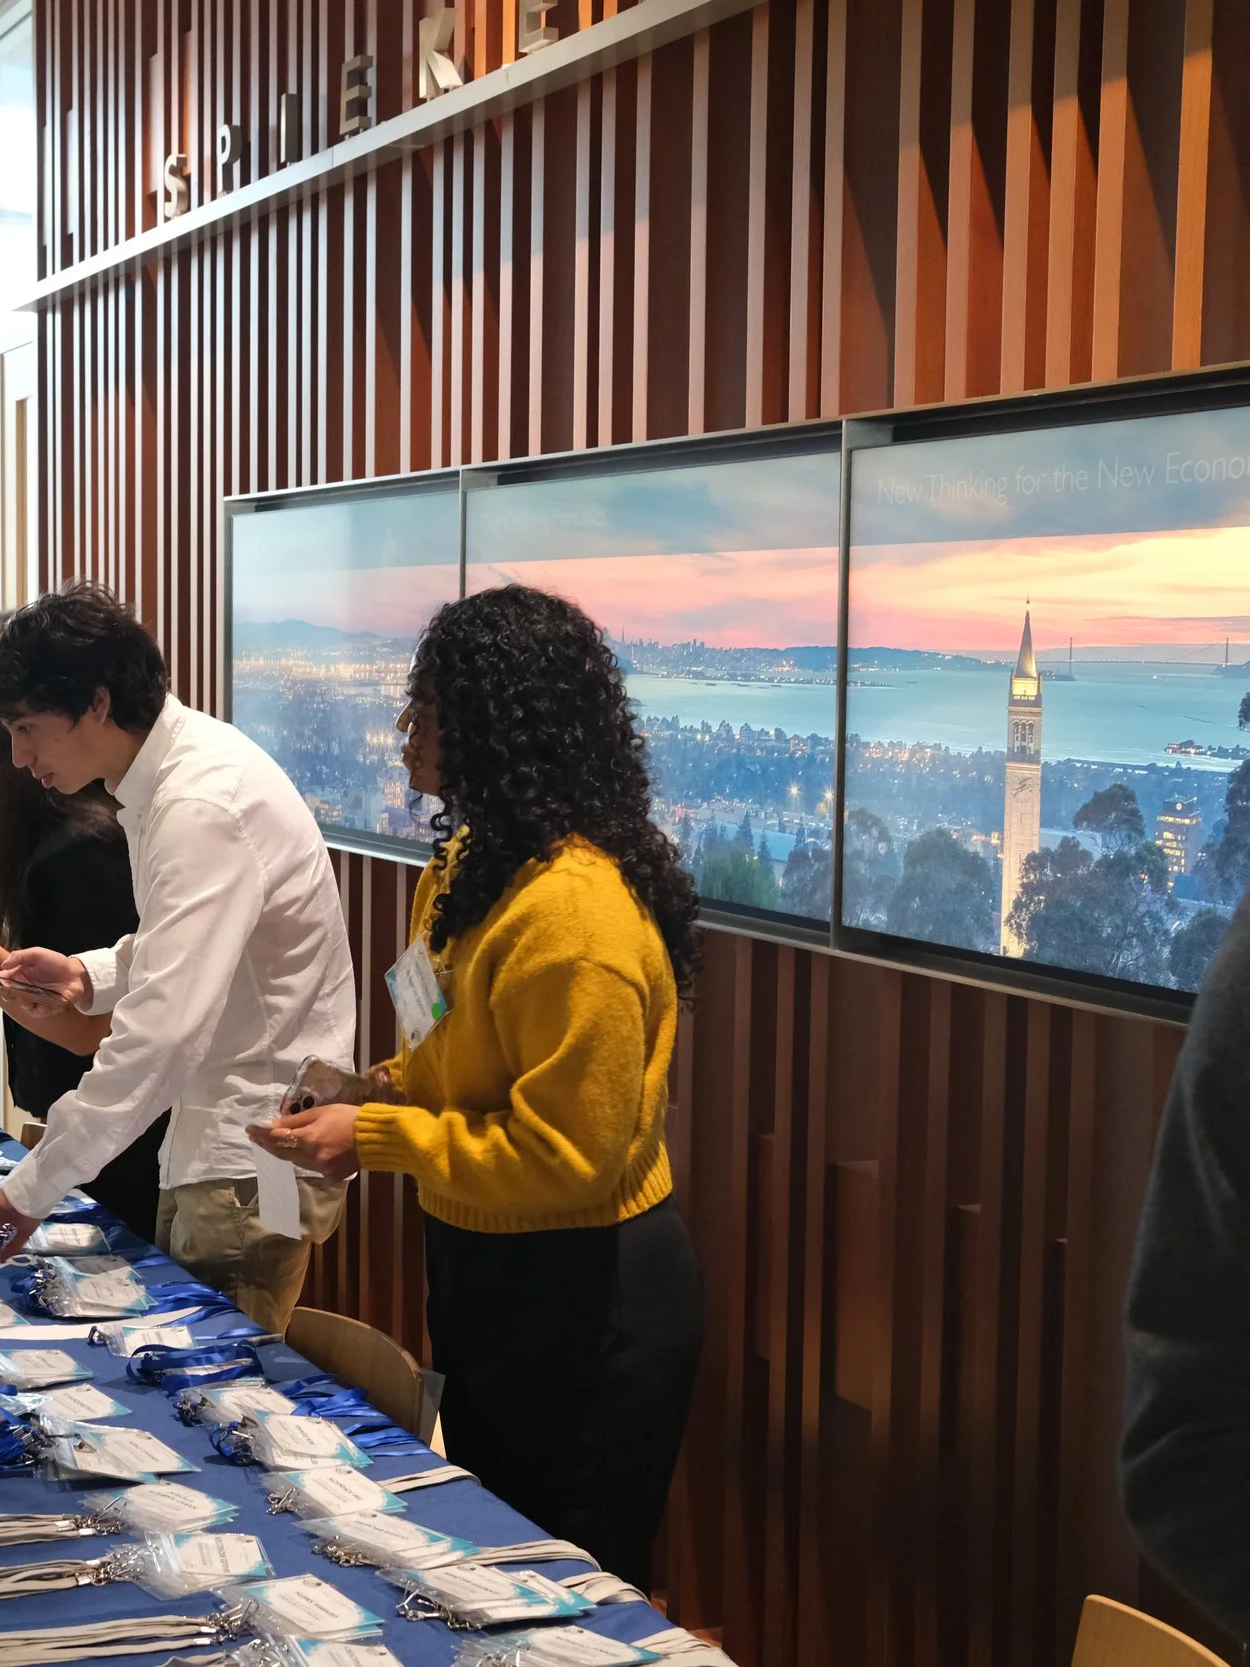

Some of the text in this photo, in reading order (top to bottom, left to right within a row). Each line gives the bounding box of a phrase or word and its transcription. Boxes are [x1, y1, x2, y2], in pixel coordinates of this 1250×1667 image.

[878, 452, 1250, 506] New Thinking for the New Econo
